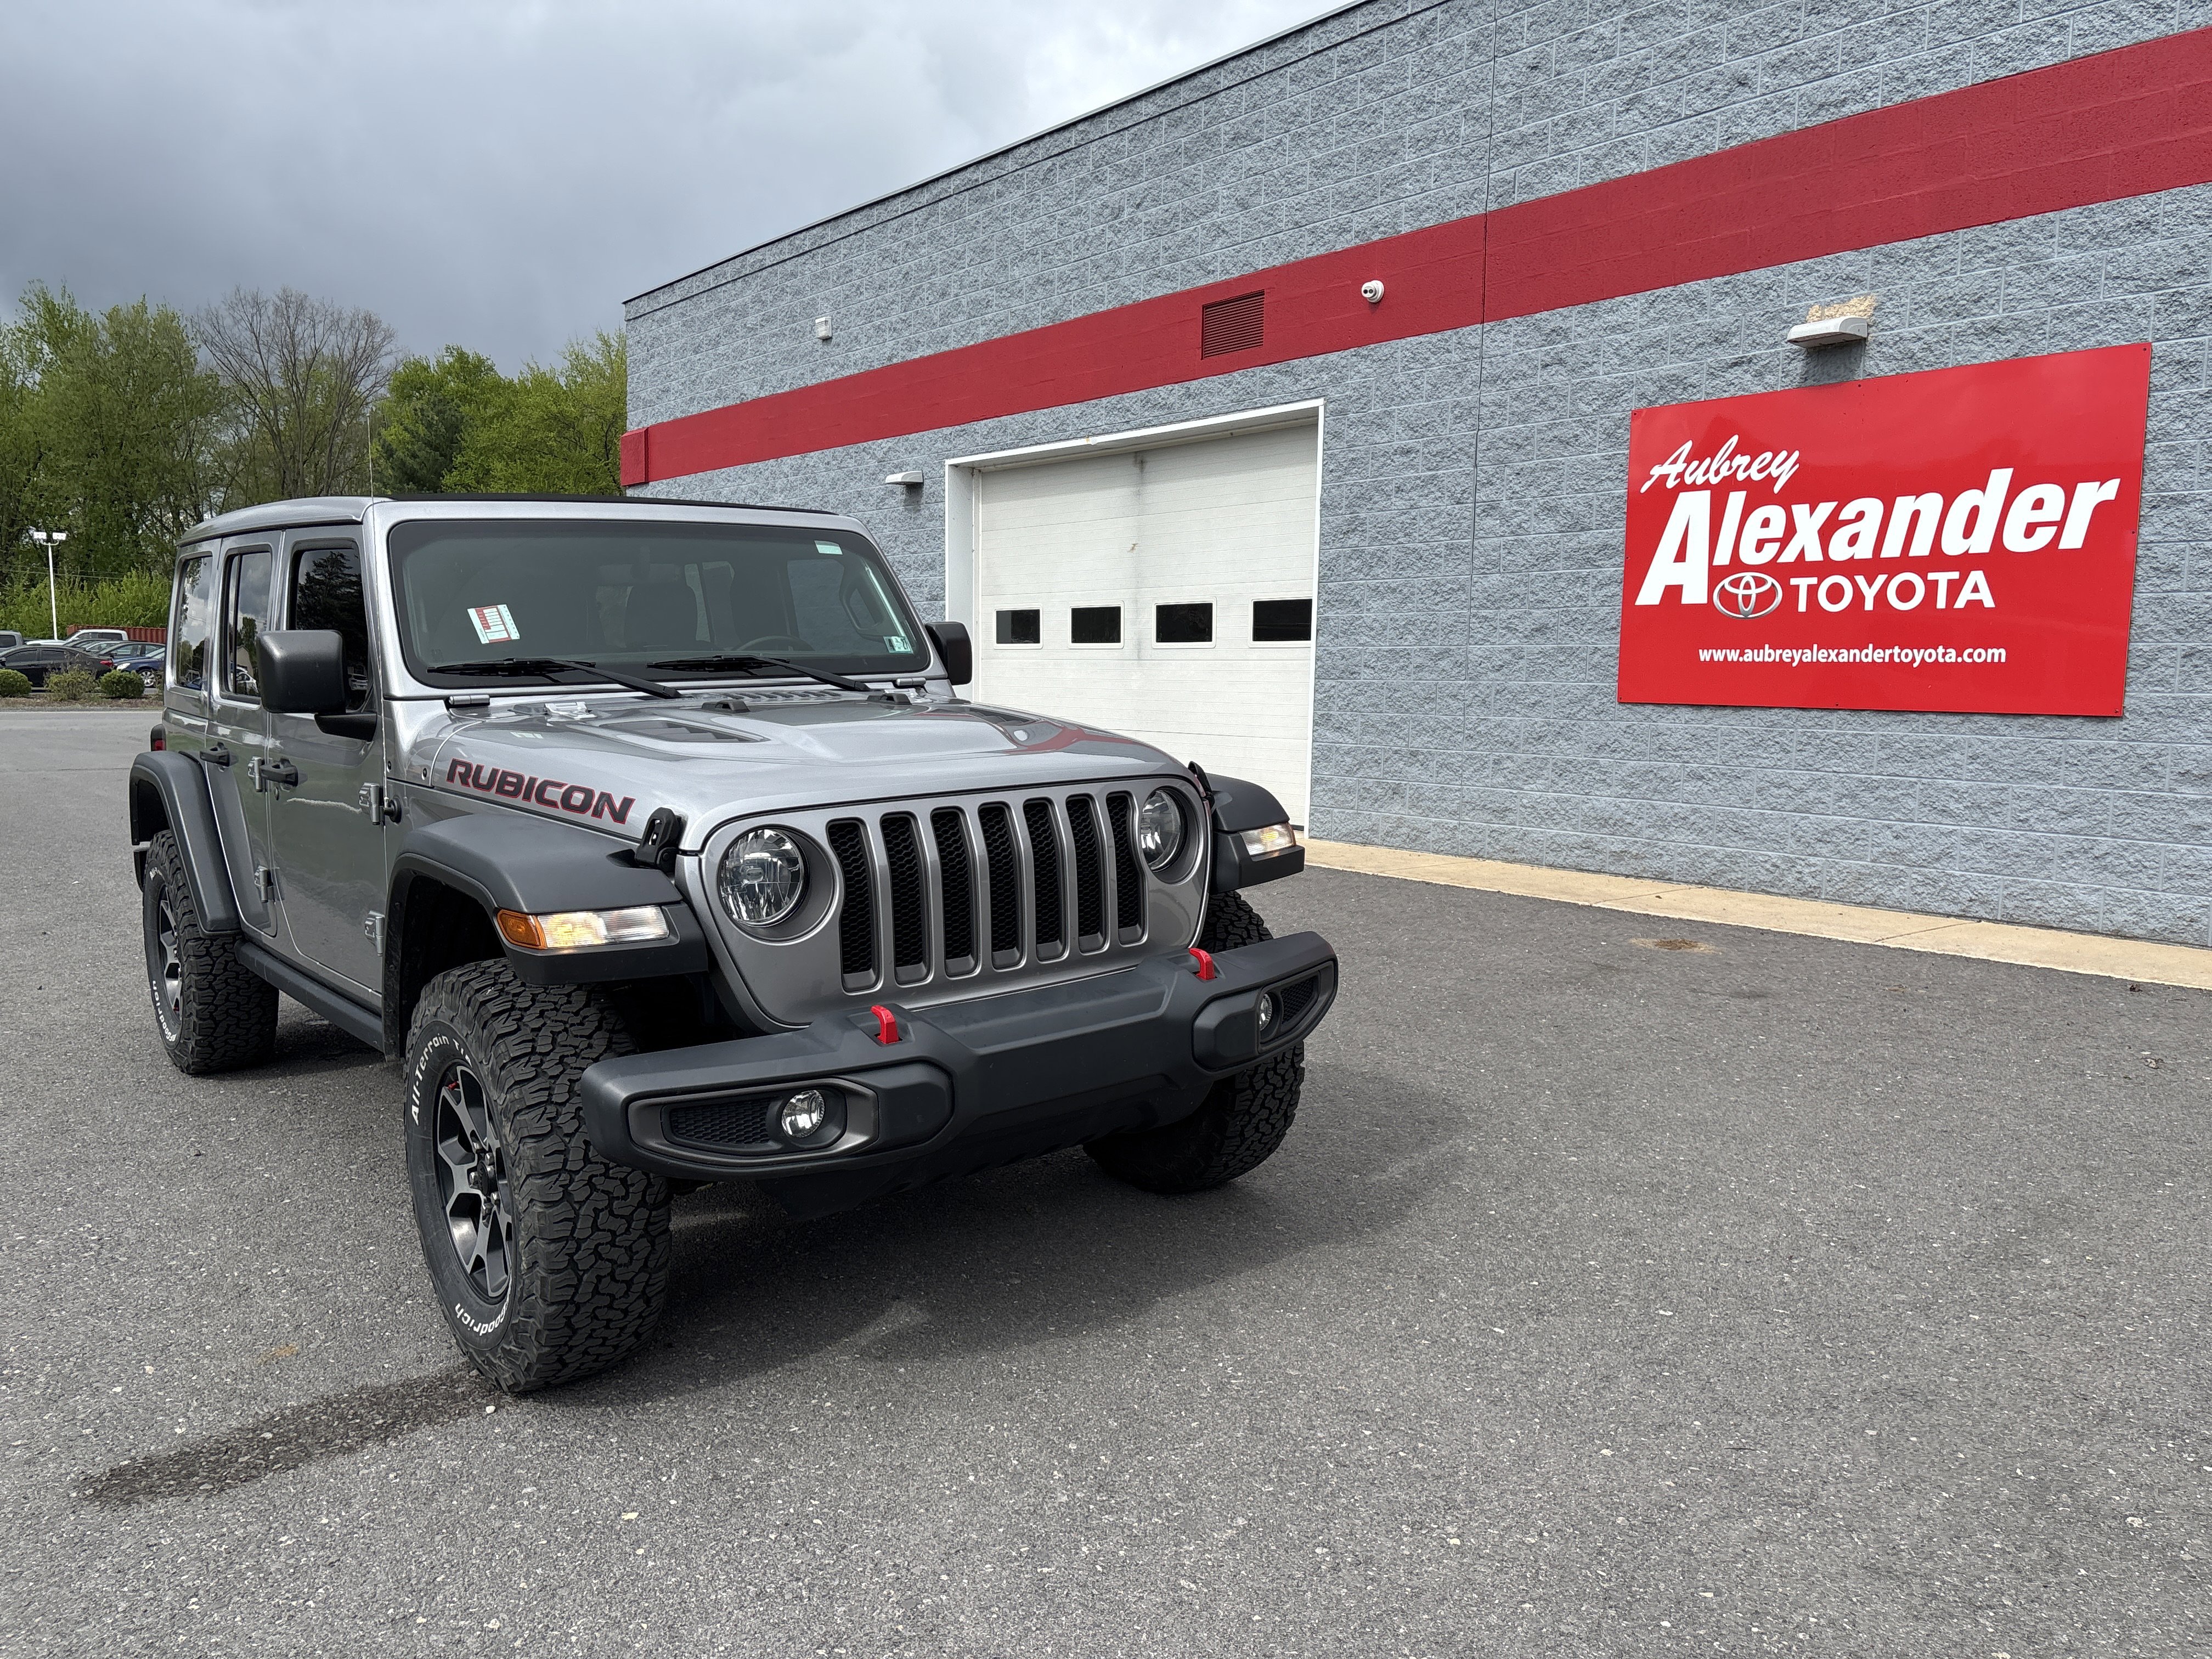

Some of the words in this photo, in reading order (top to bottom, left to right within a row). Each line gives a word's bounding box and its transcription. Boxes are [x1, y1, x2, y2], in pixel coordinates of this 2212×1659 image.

[1640, 434, 1800, 494] Aubrey
[1634, 467, 2121, 606] Alexander
[1790, 570, 1996, 613] TOYOTA
[1699, 644, 2006, 668] www.aubreyalexandertoyota.com
[446, 758, 636, 825] RUBICON
[411, 1032, 450, 1126] All-Terrain
